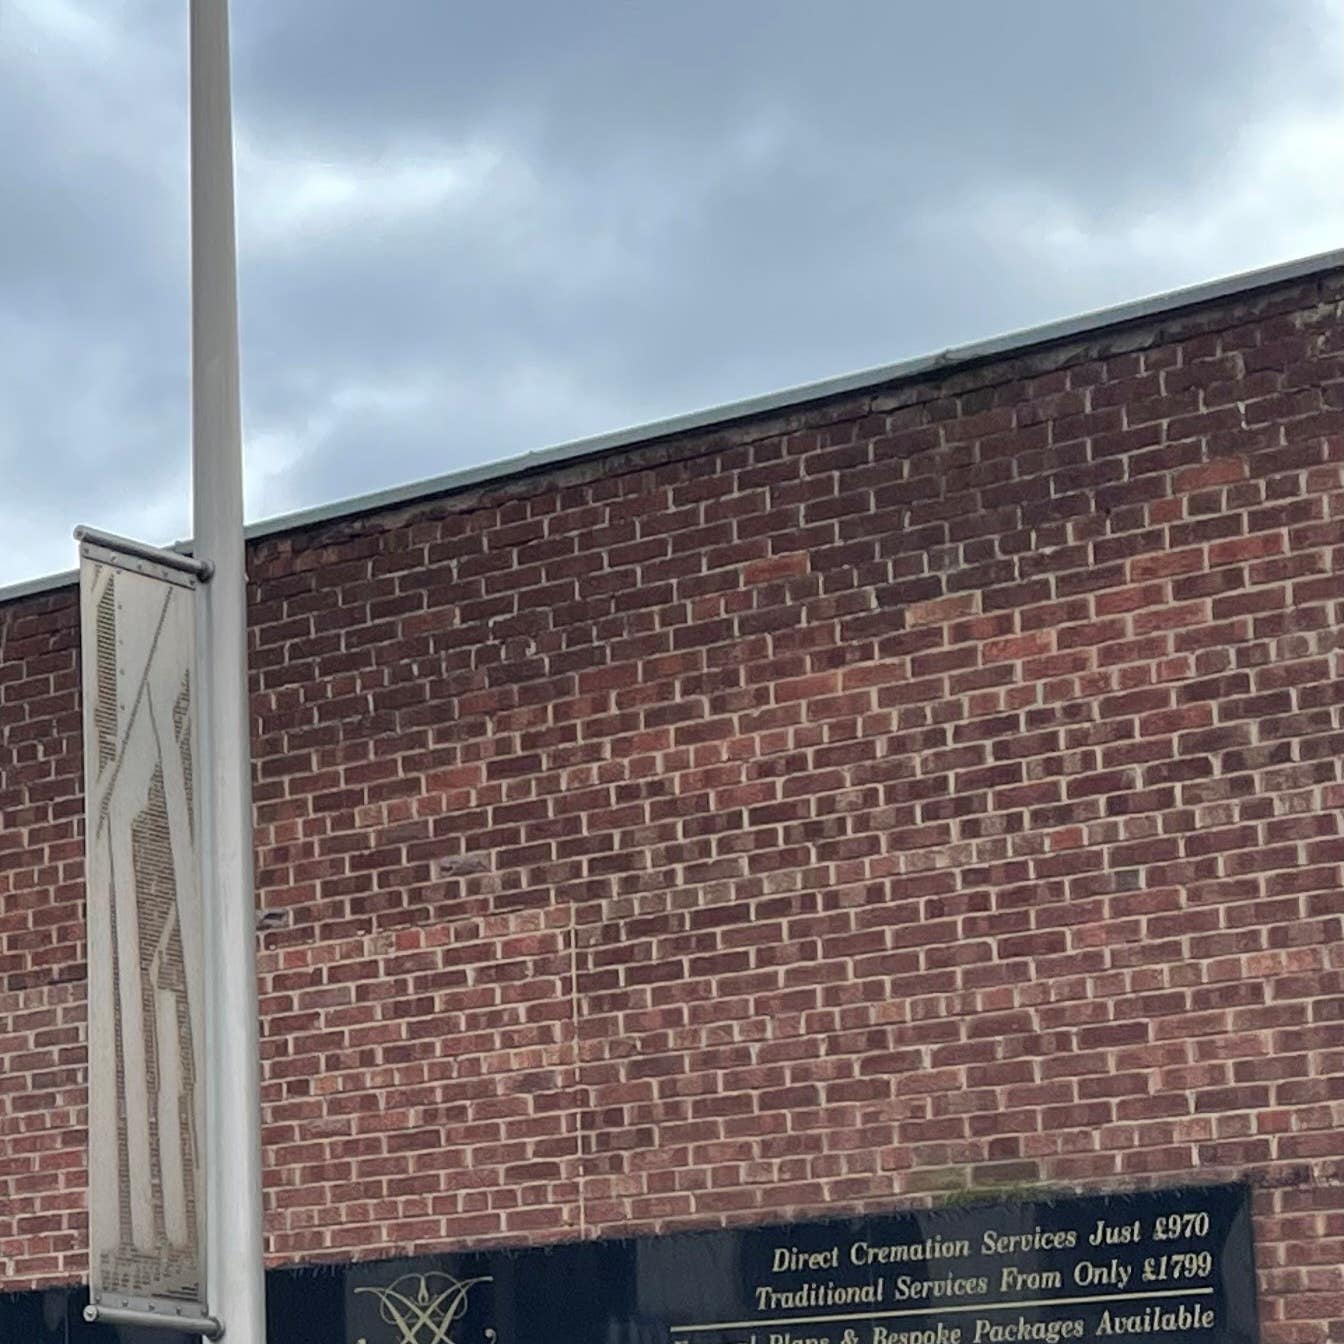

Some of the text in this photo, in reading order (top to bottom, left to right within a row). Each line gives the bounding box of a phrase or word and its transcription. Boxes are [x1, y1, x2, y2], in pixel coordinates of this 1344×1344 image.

[772, 1212, 1209, 1272] Direct Cremation Services Just £970
[756, 1251, 1212, 1311] Traditional Services From Only £1799
[973, 1316, 1084, 1344] Packages
[1096, 1304, 1214, 1336] Available
